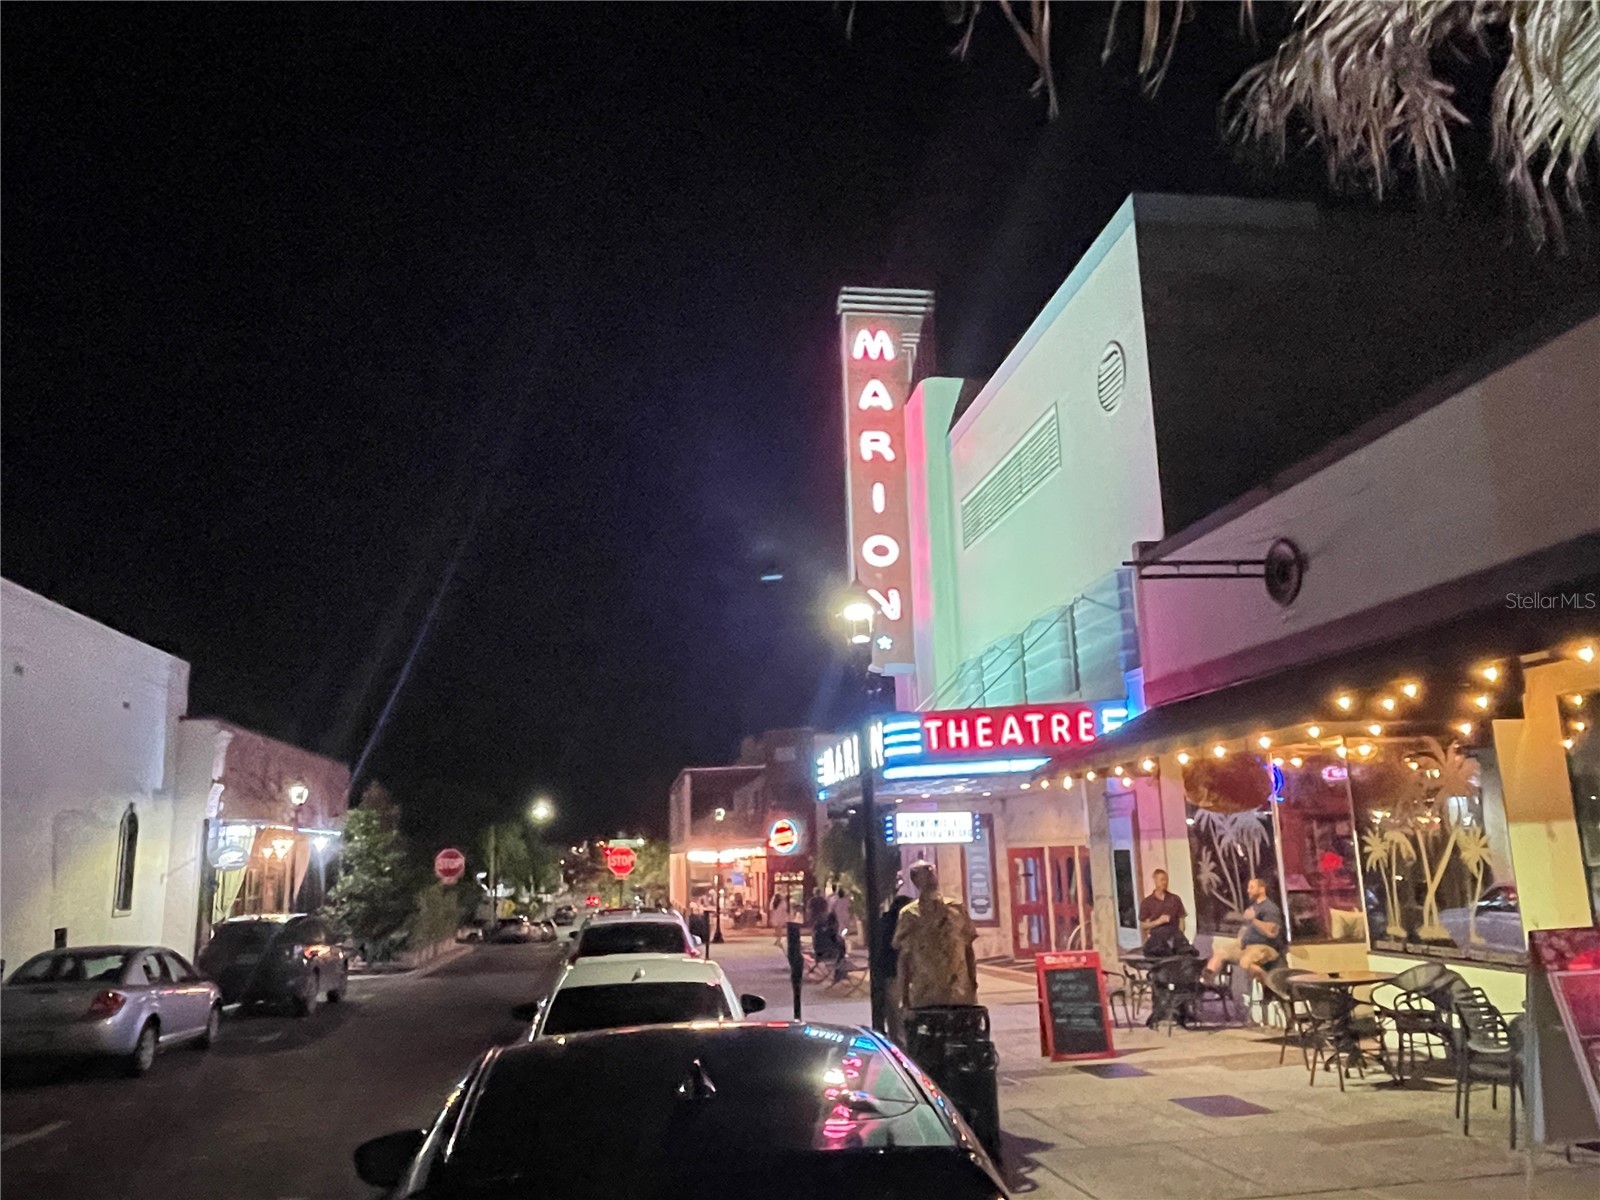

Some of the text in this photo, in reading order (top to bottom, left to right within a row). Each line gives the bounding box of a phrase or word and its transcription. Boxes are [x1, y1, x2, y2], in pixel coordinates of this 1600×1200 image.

[923, 710, 1095, 751] THEATRE
[823, 721, 884, 787] MARIN
[437, 857, 463, 870] STOP
[610, 854, 635, 867] STOP
